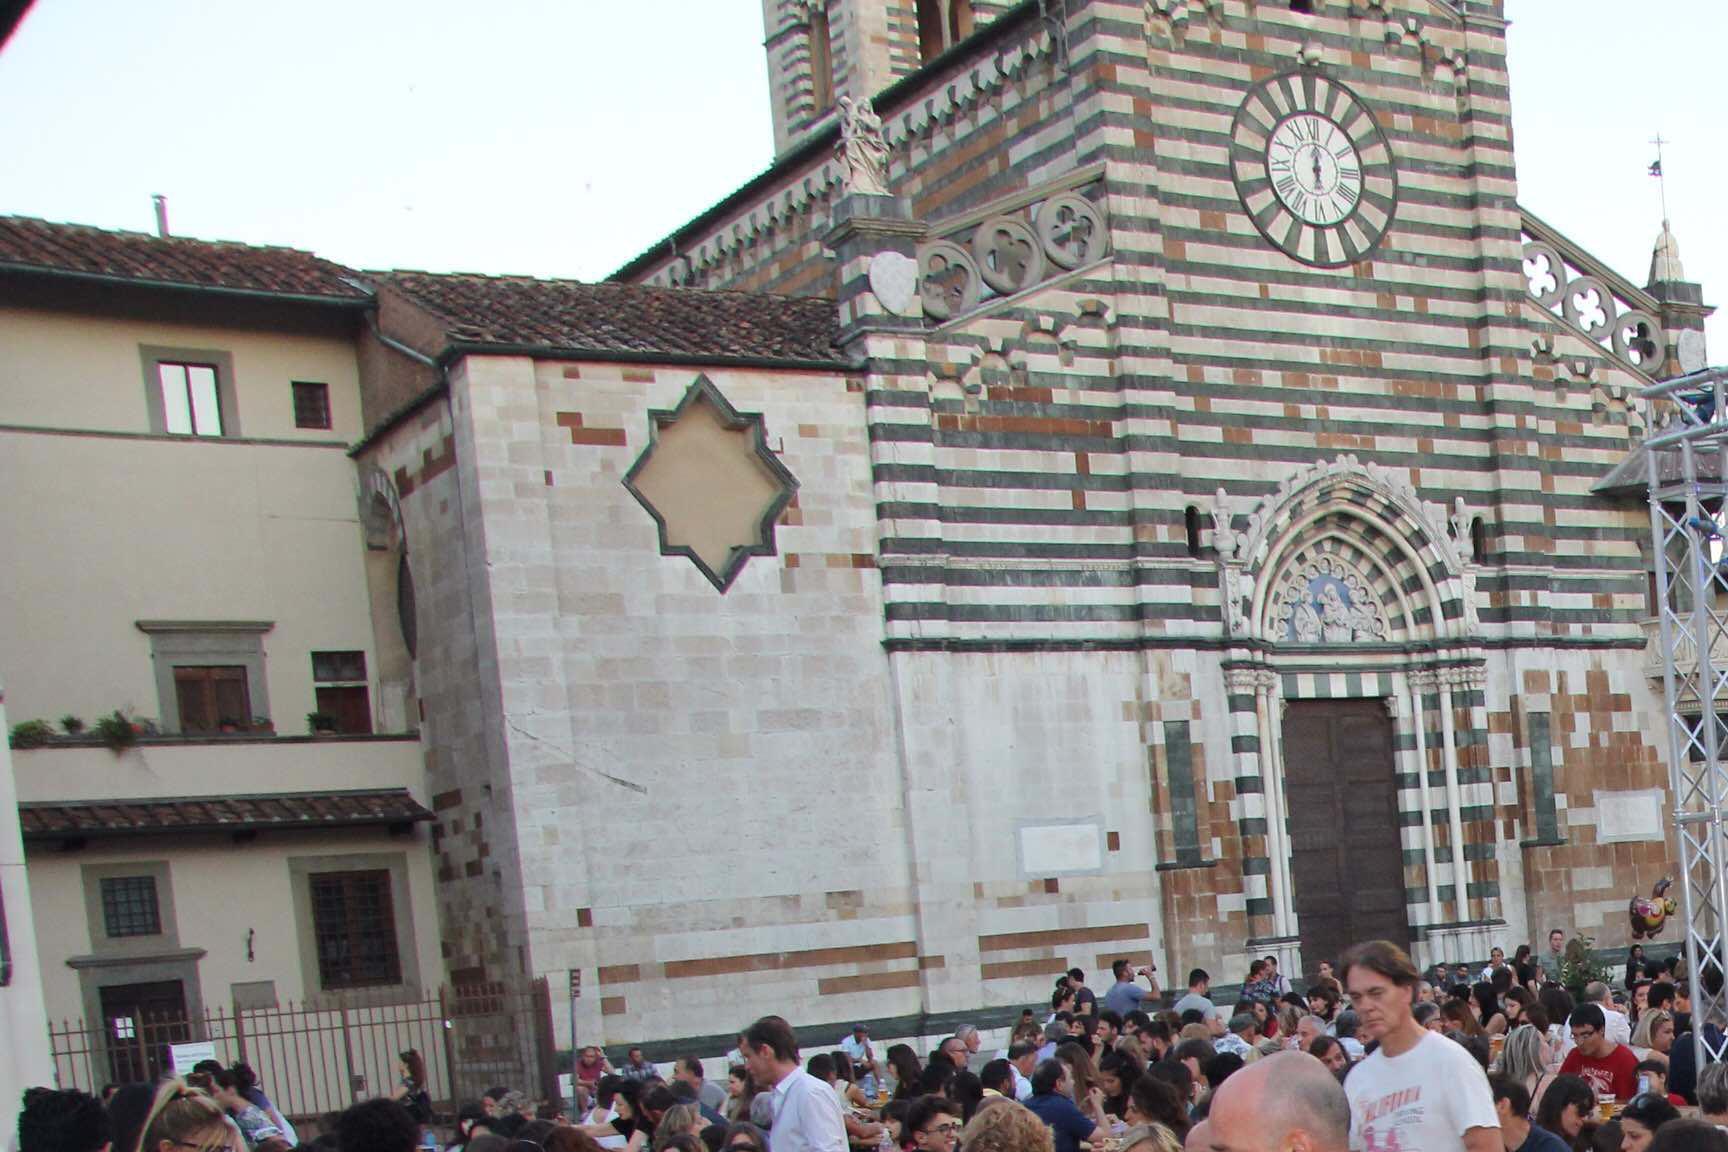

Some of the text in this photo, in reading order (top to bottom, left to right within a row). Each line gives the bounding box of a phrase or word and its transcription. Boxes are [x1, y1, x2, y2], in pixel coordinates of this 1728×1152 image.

[1286, 119, 1304, 146] XI
[1304, 117, 1320, 142] XII
[1274, 136, 1294, 155] X
[1335, 146, 1353, 160] II
[1271, 156, 1290, 171] IX
[1340, 168, 1360, 180] III
[1314, 199, 1327, 222] VI
[1331, 199, 1344, 218] V
